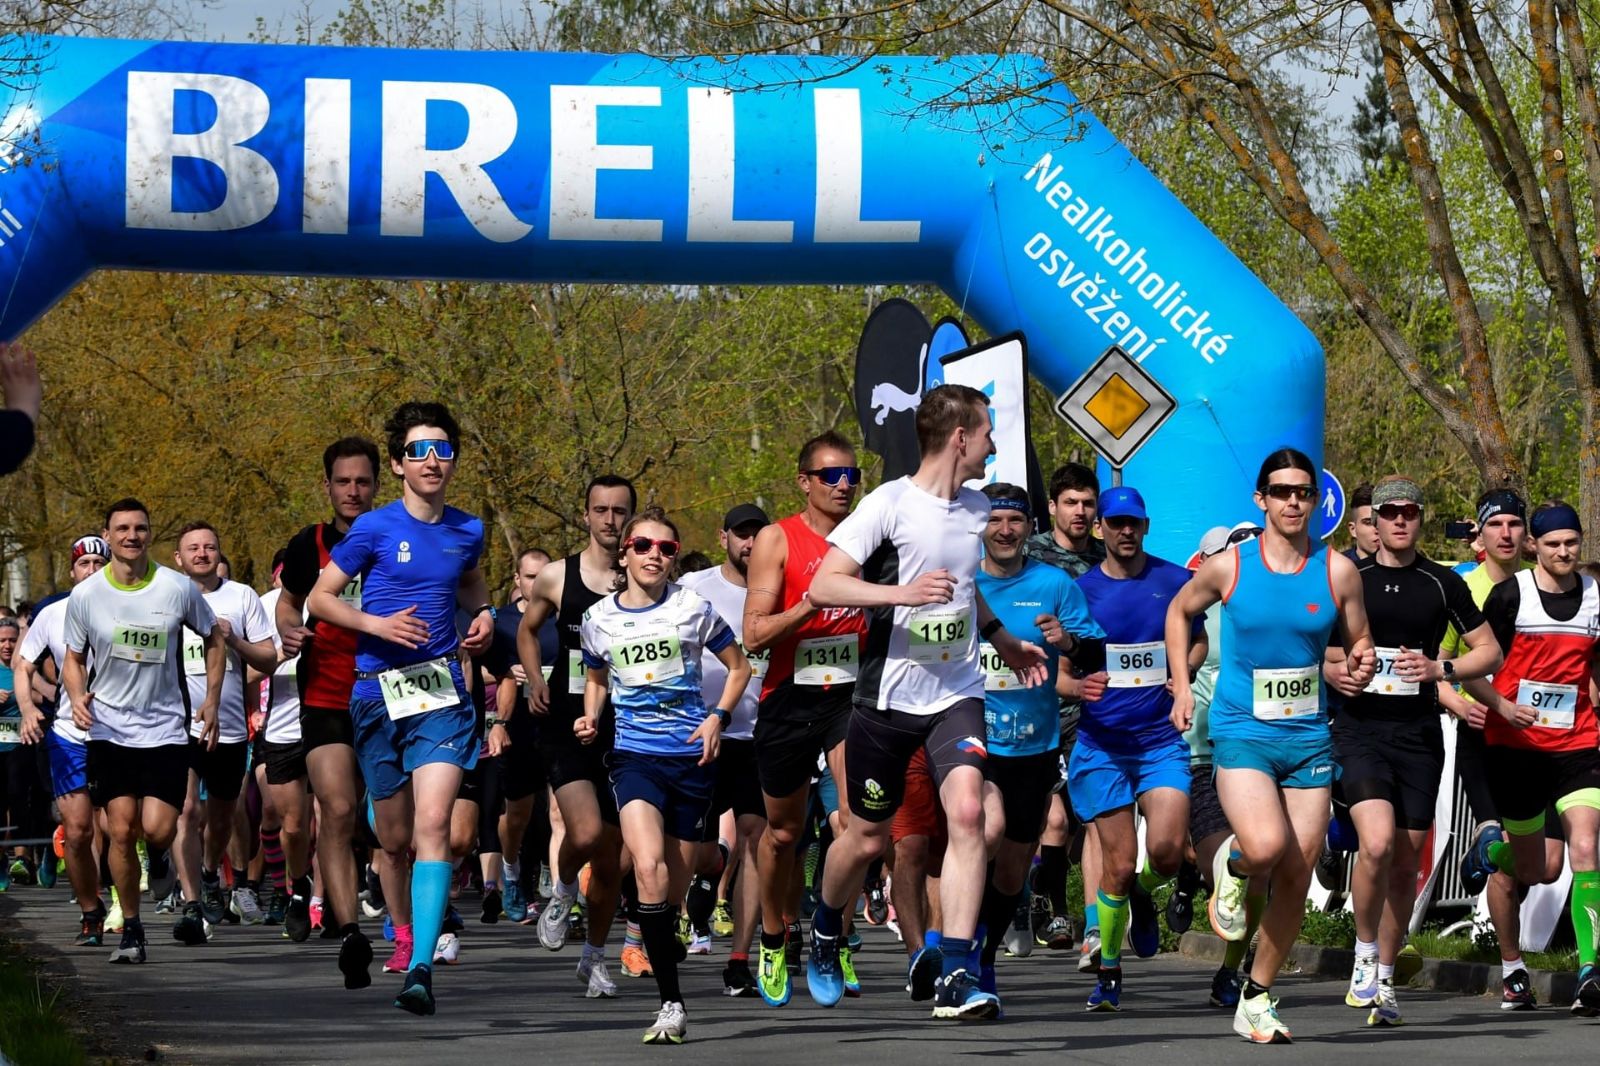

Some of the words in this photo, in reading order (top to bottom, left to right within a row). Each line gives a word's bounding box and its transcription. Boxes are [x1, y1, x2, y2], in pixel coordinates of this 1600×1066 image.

[126, 70, 921, 243] BIRELL
[1024, 152, 1233, 364] Nealkoholické
[1023, 231, 1167, 364] osvěžení
[822, 607, 861, 621] TEAM
[122, 630, 159, 647] 1191
[921, 620, 965, 643] 1192
[188, 644, 204, 659] 11
[620, 640, 672, 665] 1285
[804, 645, 851, 666] 1314
[1120, 652, 1153, 669] 966
[1374, 658, 1397, 675] 97
[392, 671, 442, 698] 1301
[1263, 678, 1311, 699] 1098
[1531, 691, 1564, 709] 977
